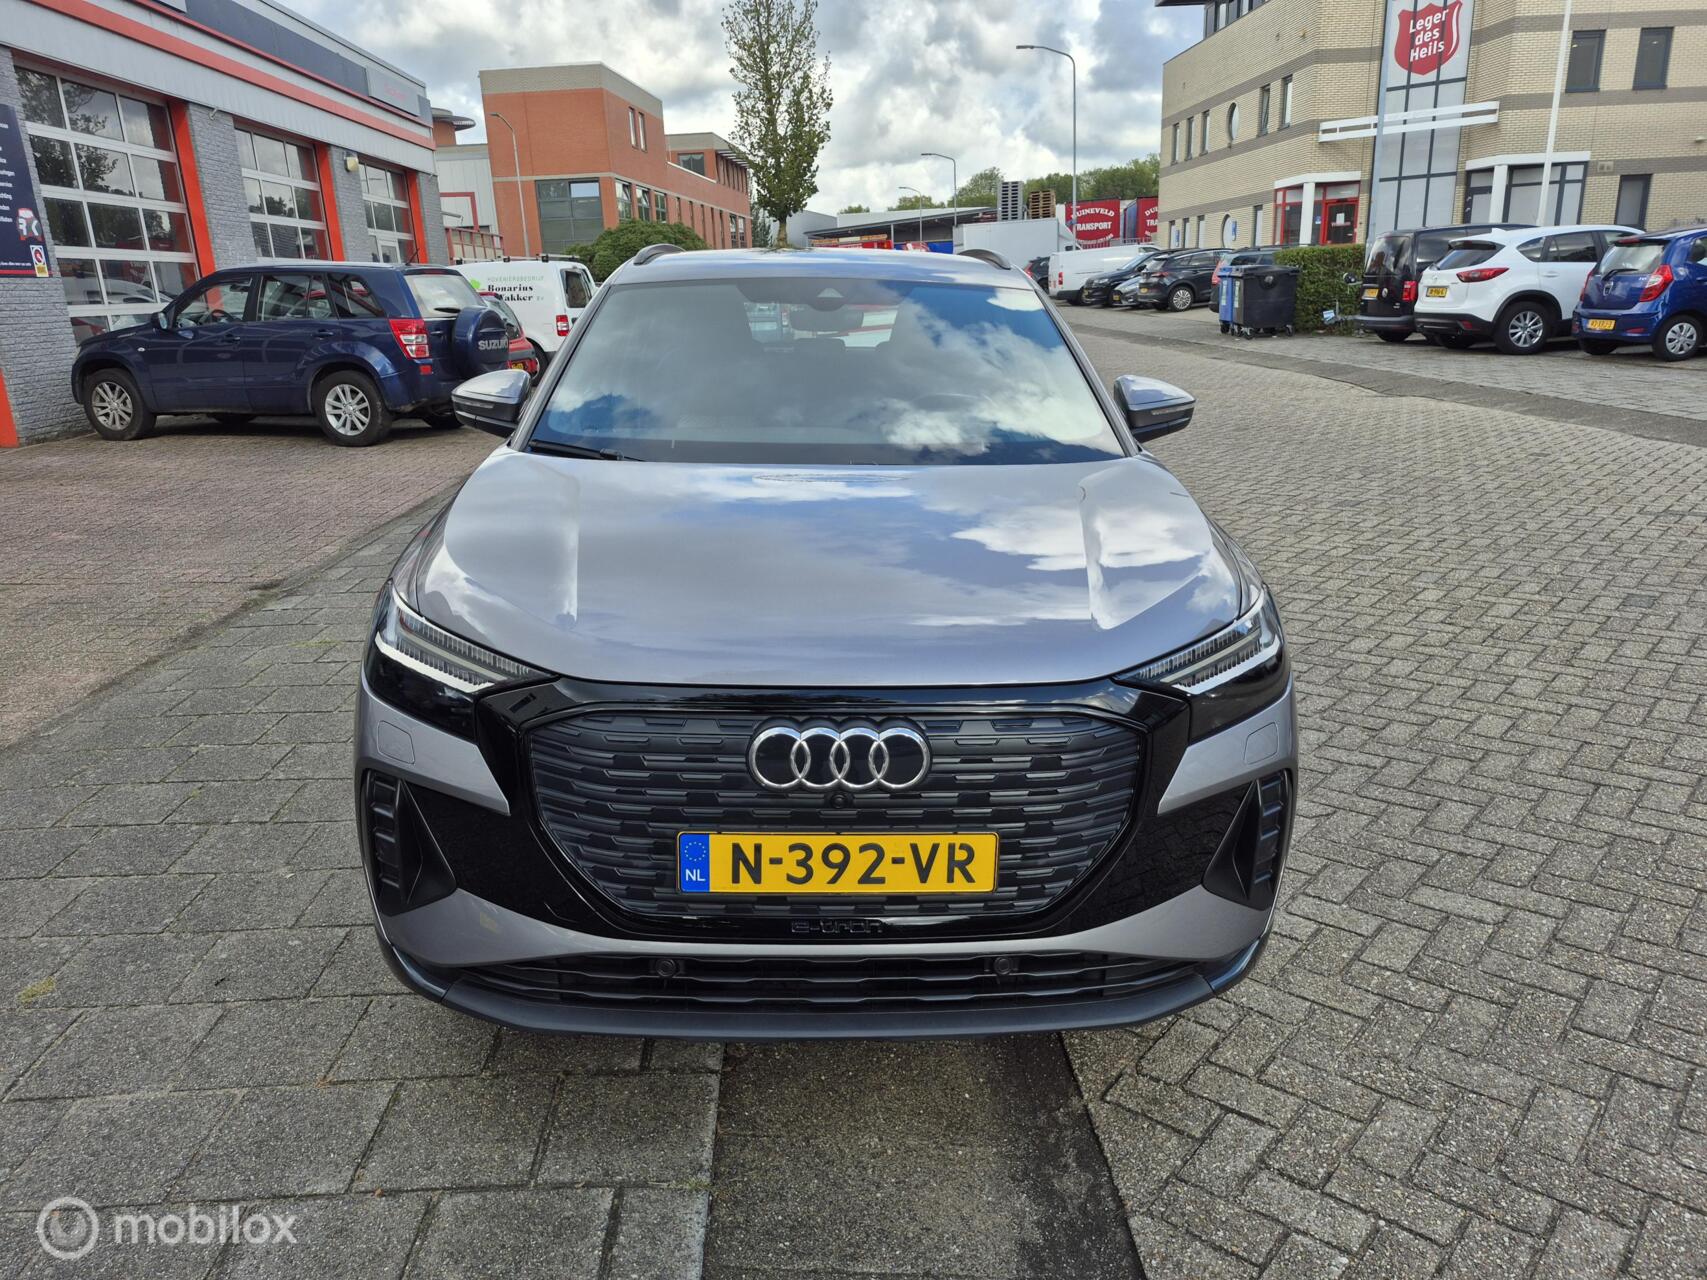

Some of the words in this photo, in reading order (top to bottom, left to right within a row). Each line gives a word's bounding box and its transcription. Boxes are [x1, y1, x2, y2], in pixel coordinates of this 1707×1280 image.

[1409, 9, 1449, 33] Leger
[1415, 28, 1440, 46] des
[1410, 41, 1445, 62] Heils
[1071, 207, 1115, 218] UINEVELD
[1074, 221, 1112, 231] RANSPORT
[487, 284, 533, 292] Bonarius
[731, 842, 977, 885] N-392-VR
[685, 868, 706, 882] NL
